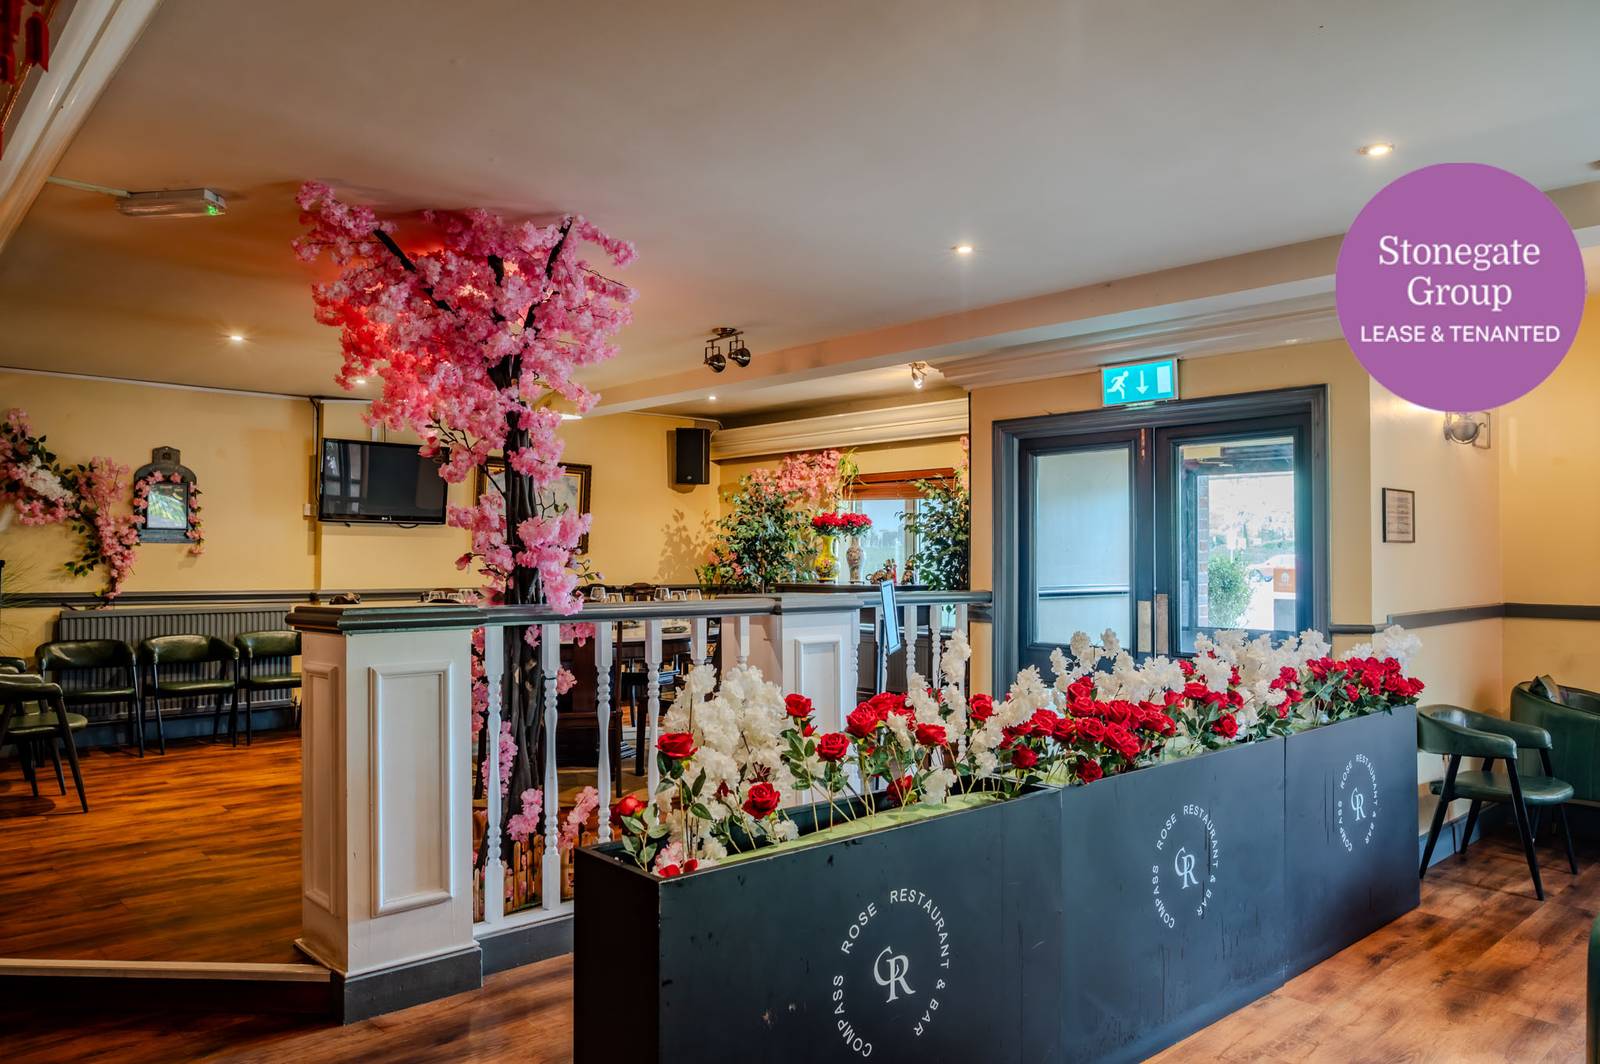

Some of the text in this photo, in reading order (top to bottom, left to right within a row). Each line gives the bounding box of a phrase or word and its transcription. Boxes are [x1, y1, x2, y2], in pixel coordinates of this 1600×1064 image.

[1156, 813, 1177, 850] ROSE
[1183, 804, 1219, 868] RESTAURANT
[1152, 865, 1175, 928] COMPASS
[1196, 889, 1212, 916] BAR
[832, 888, 950, 1057] COMPASS ROSE RESTAURANT & BAR
